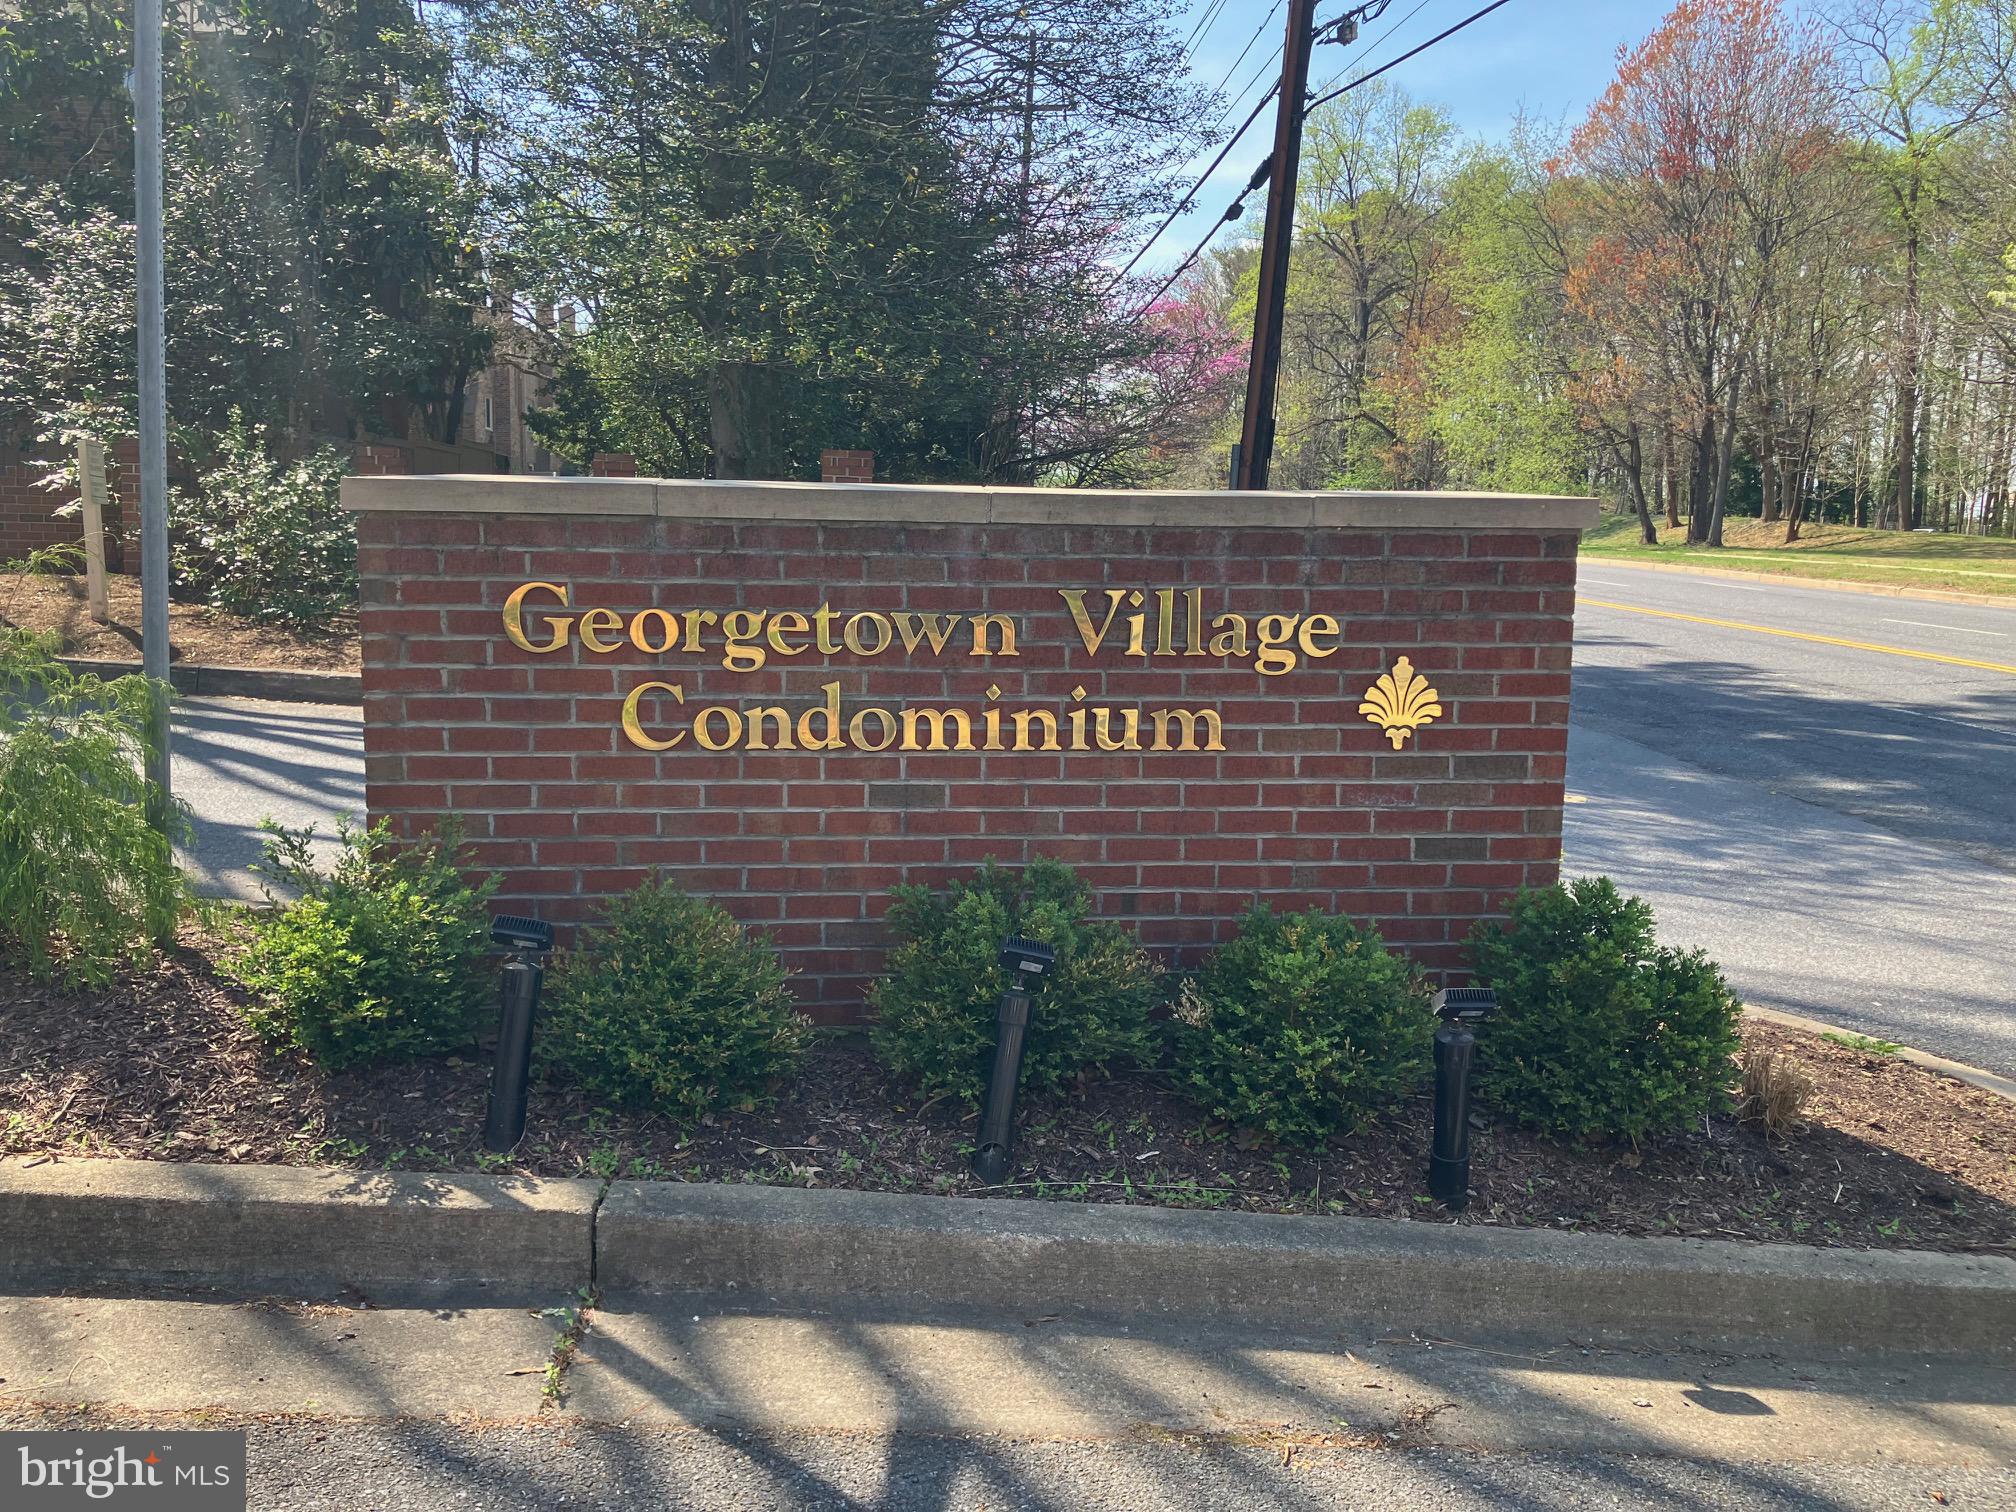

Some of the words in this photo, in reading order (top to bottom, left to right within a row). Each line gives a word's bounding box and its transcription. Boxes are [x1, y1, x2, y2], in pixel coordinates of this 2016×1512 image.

[502, 581, 1020, 673] Georgetown
[1058, 586, 1340, 676] Village
[621, 681, 1227, 752] Condominium
